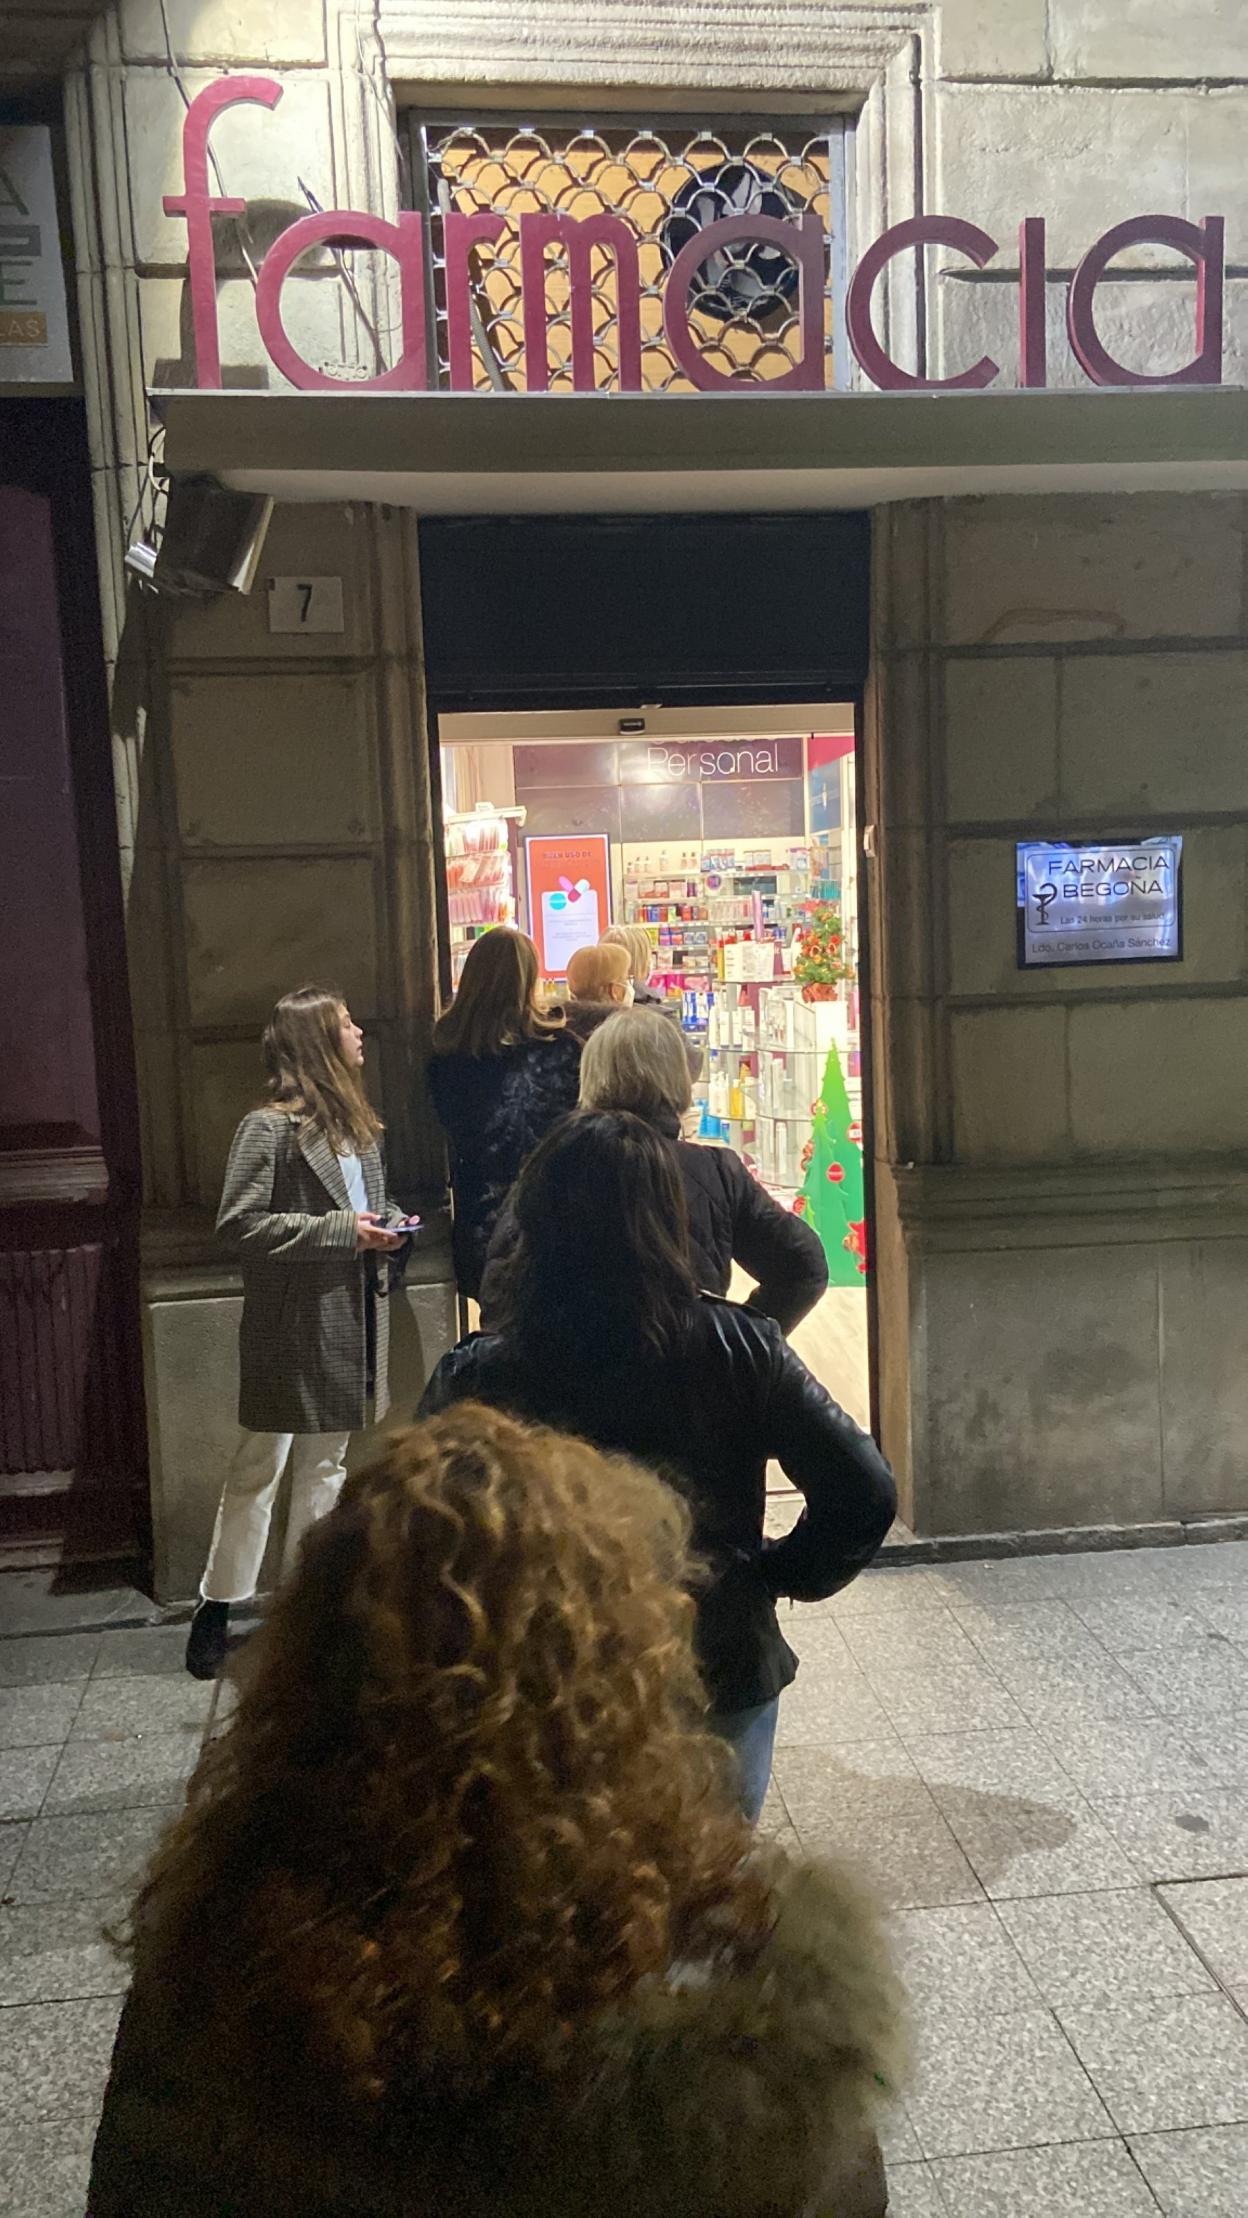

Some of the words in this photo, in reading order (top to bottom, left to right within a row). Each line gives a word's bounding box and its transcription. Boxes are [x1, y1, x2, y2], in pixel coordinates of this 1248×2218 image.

[163, 75, 1224, 391] farmacia
[296, 583, 313, 622] 7
[647, 743, 779, 776] Personal
[1048, 856, 1169, 875] FARMACIA
[1063, 875, 1163, 898] BEGOÑA
[1077, 916, 1087, 924] 24
[1089, 914, 1112, 923] horas
[1114, 914, 1128, 922] por
[1057, 940, 1089, 951] Carlos
[1091, 938, 1124, 949] Ocaña
[1127, 936, 1170, 947] Sánchez
